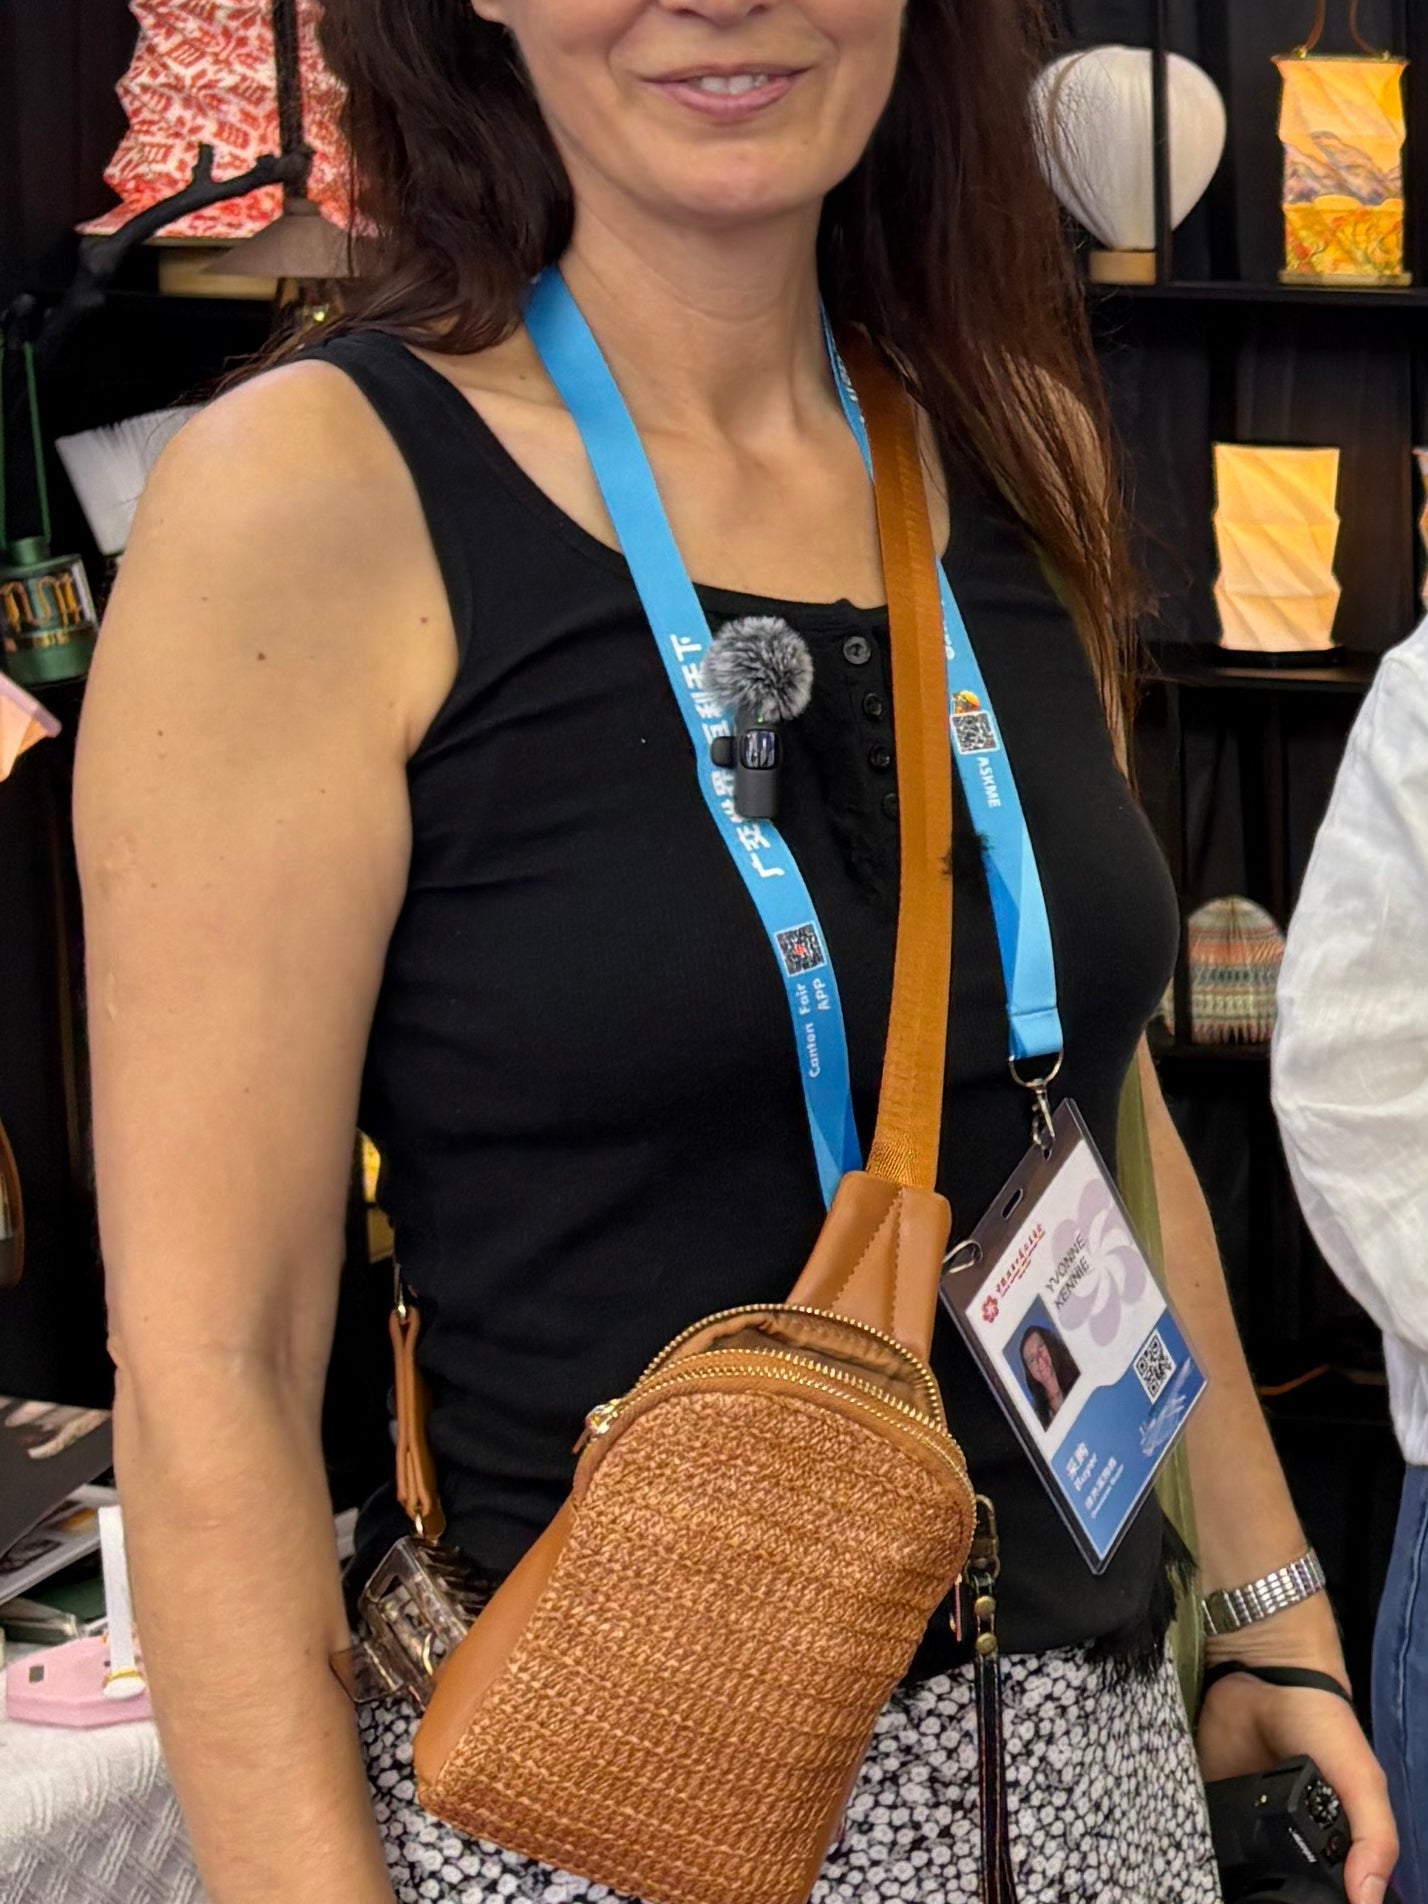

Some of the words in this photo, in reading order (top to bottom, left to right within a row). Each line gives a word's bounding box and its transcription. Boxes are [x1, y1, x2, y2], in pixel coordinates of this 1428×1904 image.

[975, 756, 1001, 809] ASKME
[799, 983, 809, 1016] Fair
[815, 977, 831, 1011] APP
[808, 1022, 820, 1078] Canton
[1045, 1233, 1086, 1292] YVONNE
[1054, 1256, 1090, 1310] KENNIE
